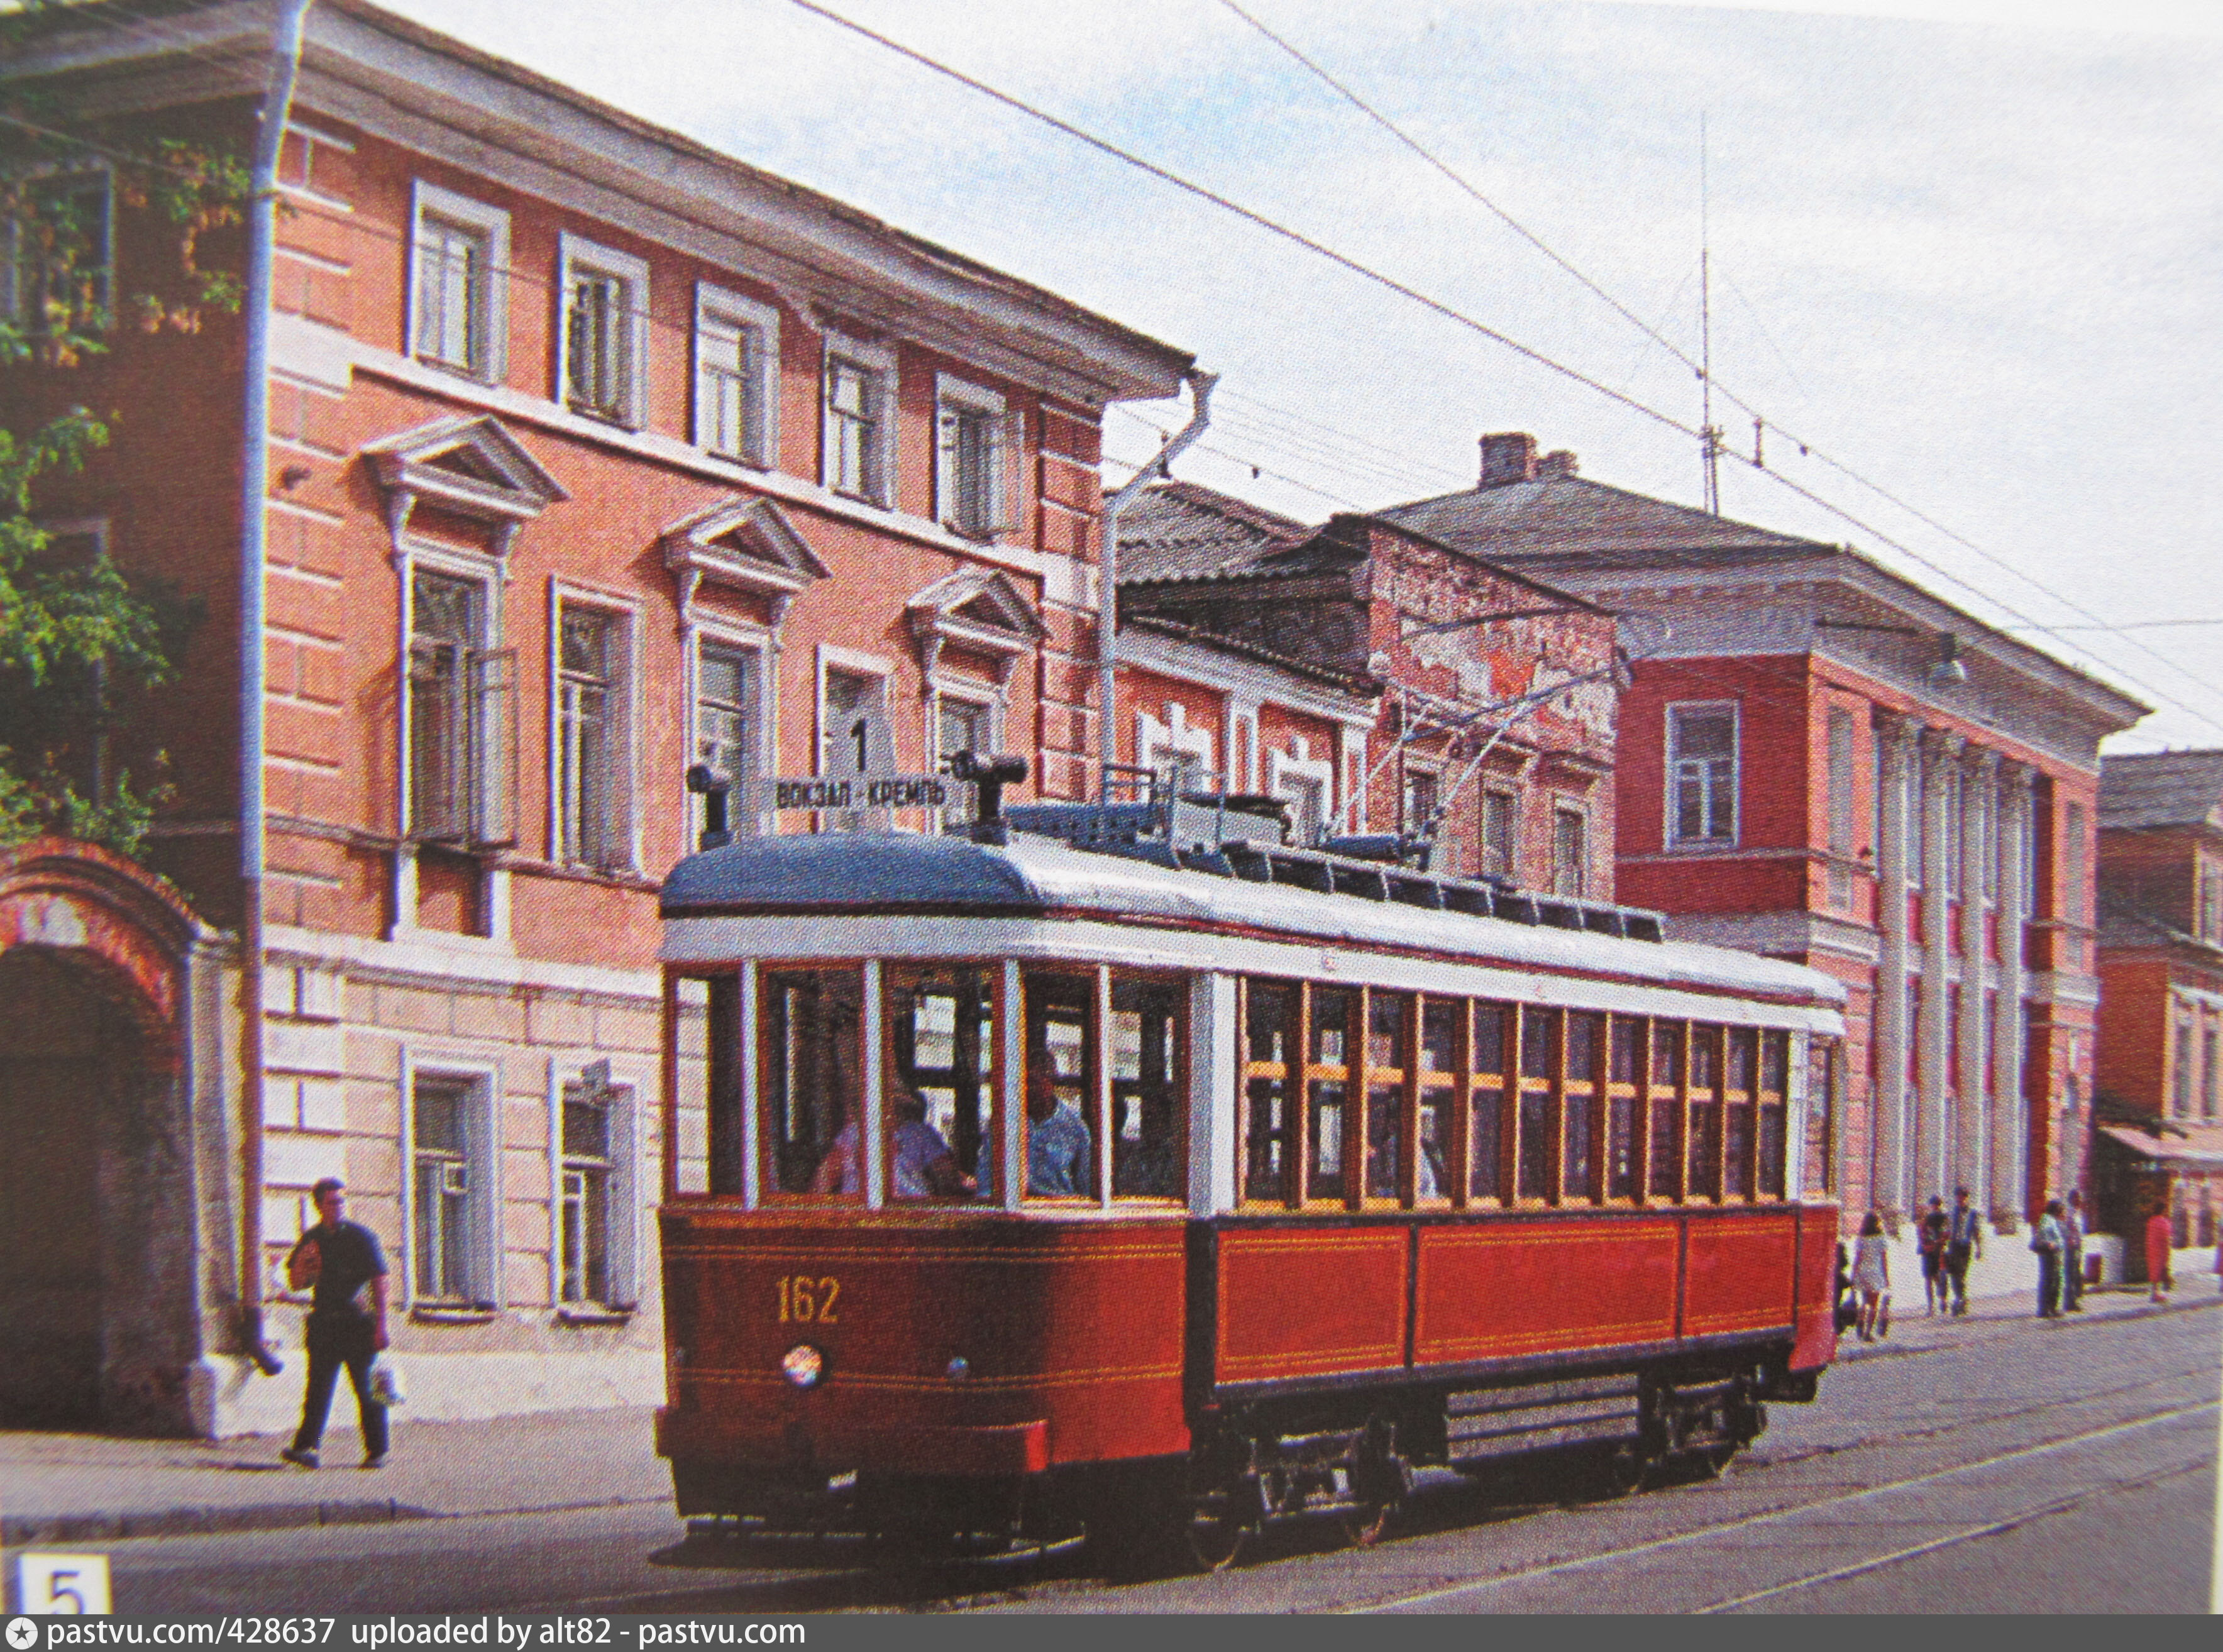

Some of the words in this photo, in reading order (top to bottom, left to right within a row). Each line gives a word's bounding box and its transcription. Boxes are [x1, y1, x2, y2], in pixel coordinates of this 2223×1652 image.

[851, 719, 866, 772] 1
[776, 781, 850, 808] ВОКЗАЛ
[868, 779, 945, 807] КРЕМЛЬ
[776, 1275, 840, 1323] 162
